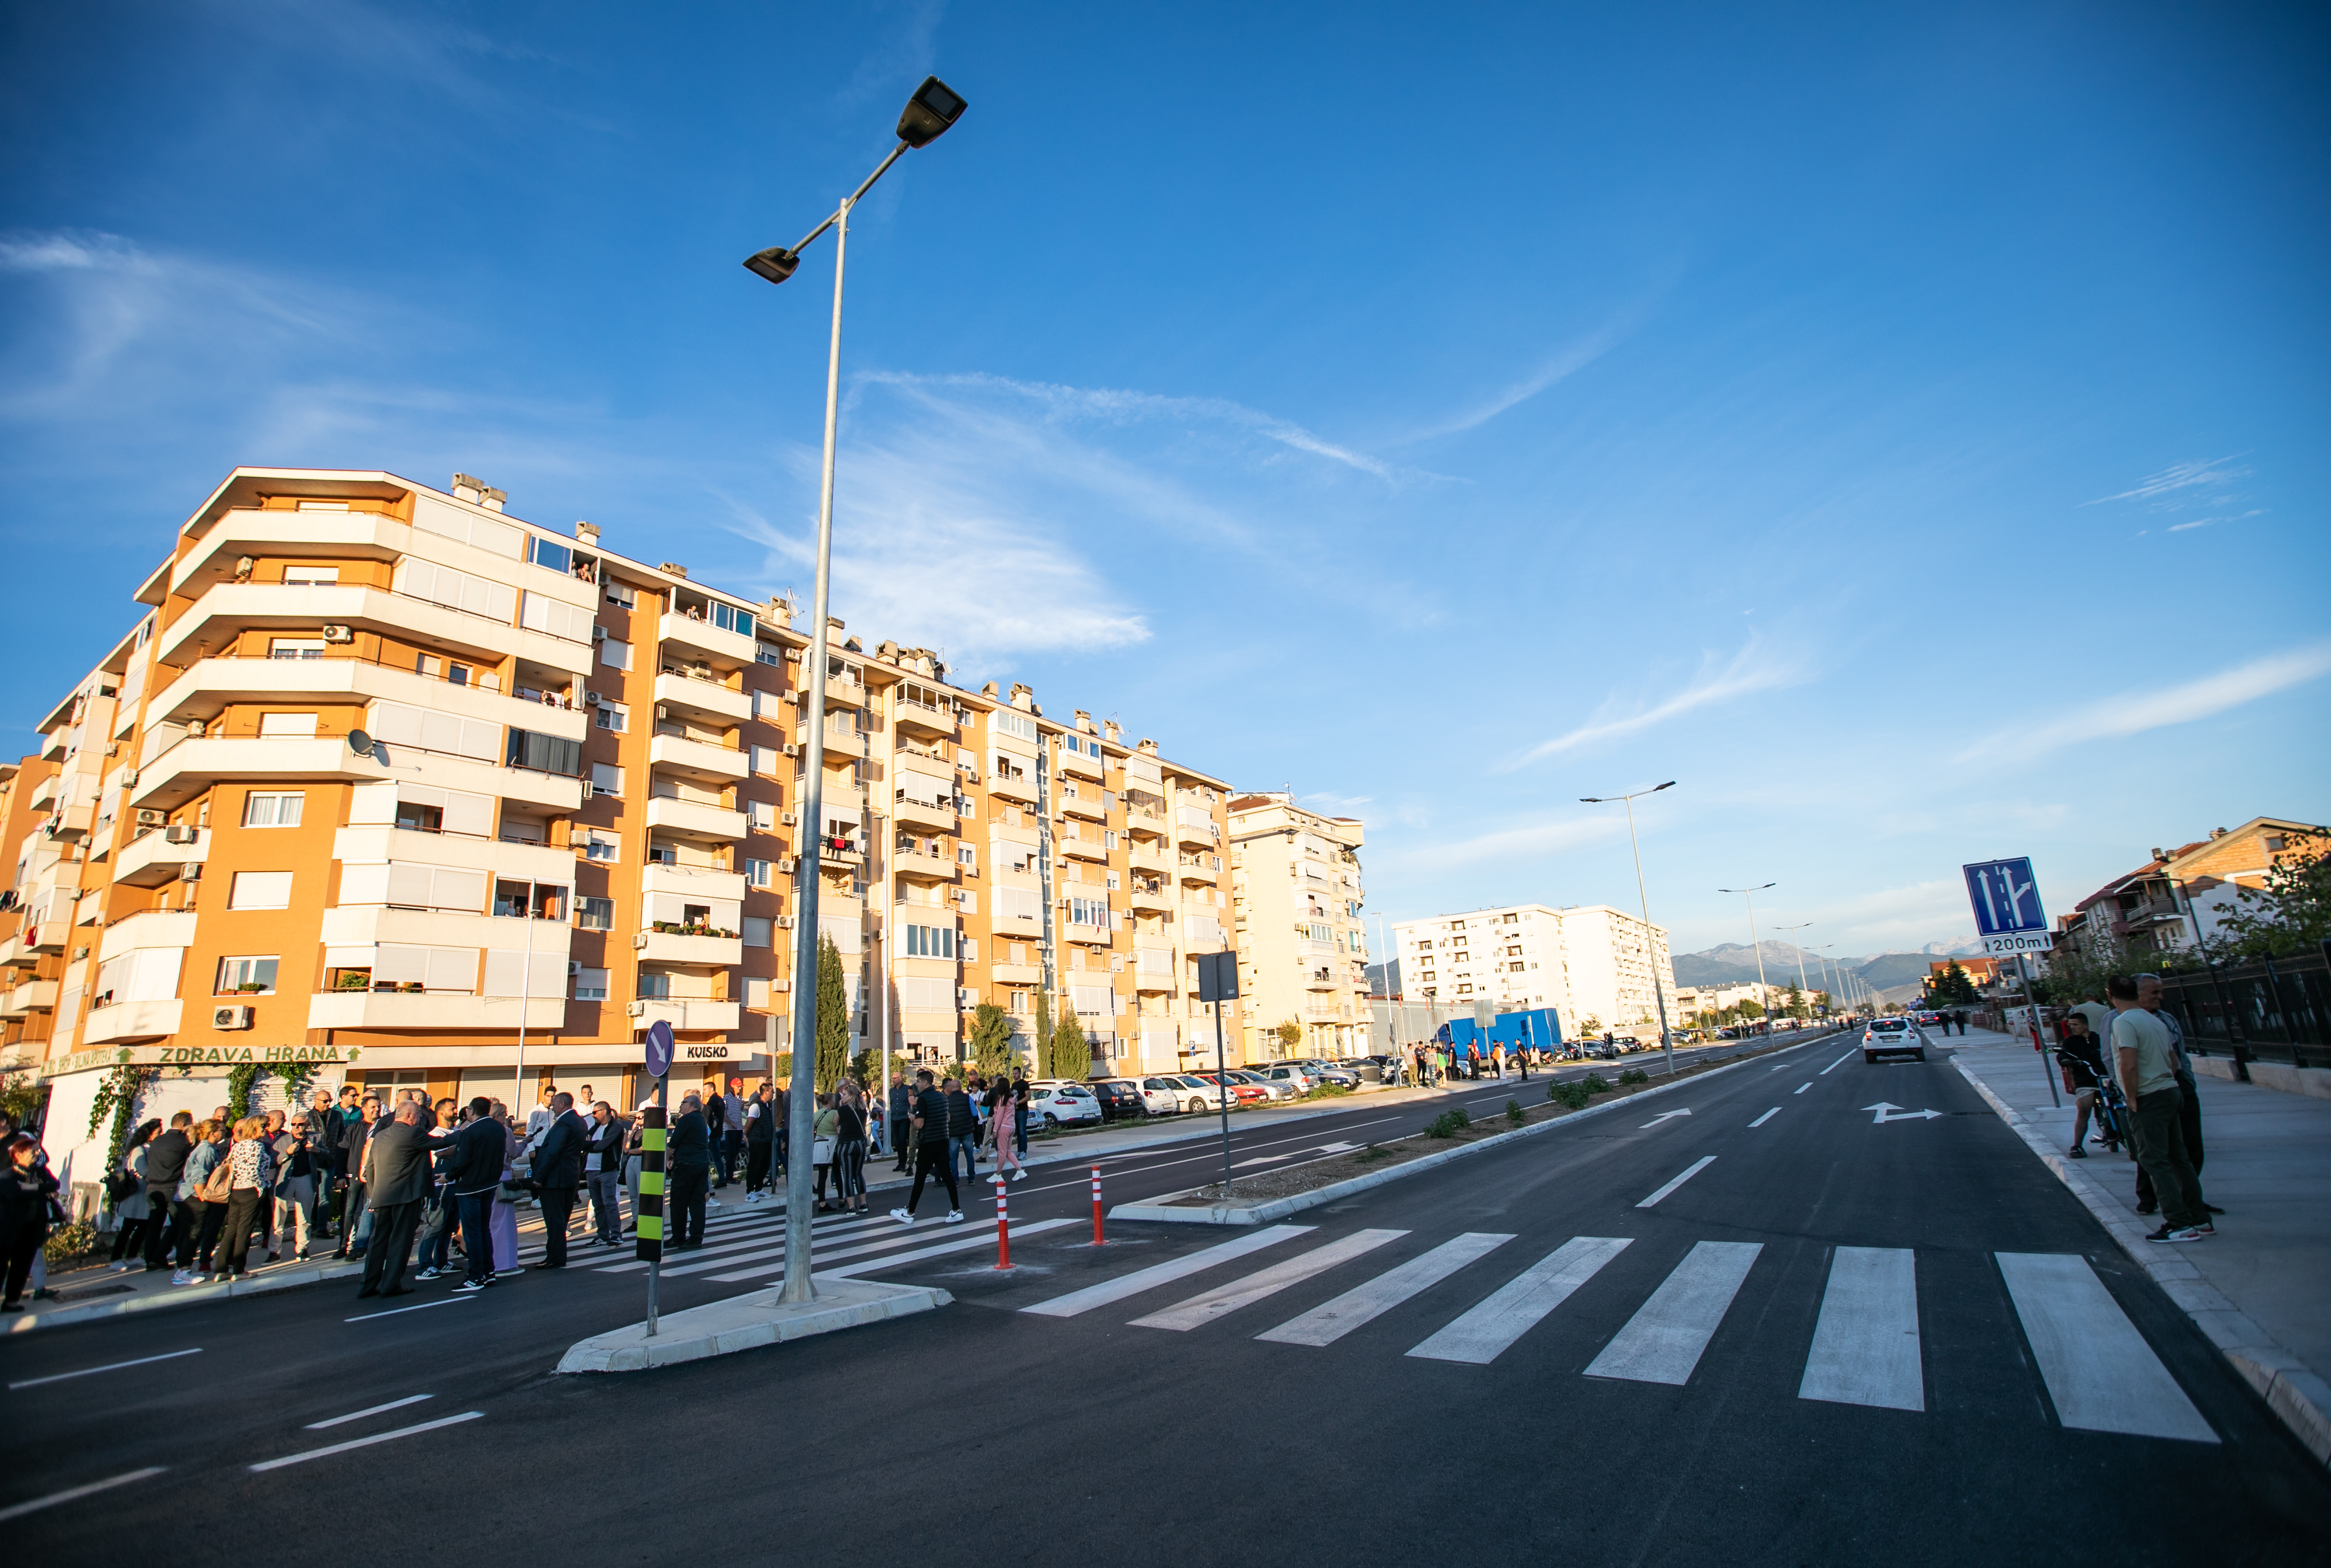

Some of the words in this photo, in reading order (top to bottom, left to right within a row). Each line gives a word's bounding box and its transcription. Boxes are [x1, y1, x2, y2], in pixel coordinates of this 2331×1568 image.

[1993, 937, 2042, 951] 200m
[160, 1047, 253, 1062] ZDRAVA
[265, 1046, 339, 1061] HRANA
[58, 1057, 70, 1072] SHOP
